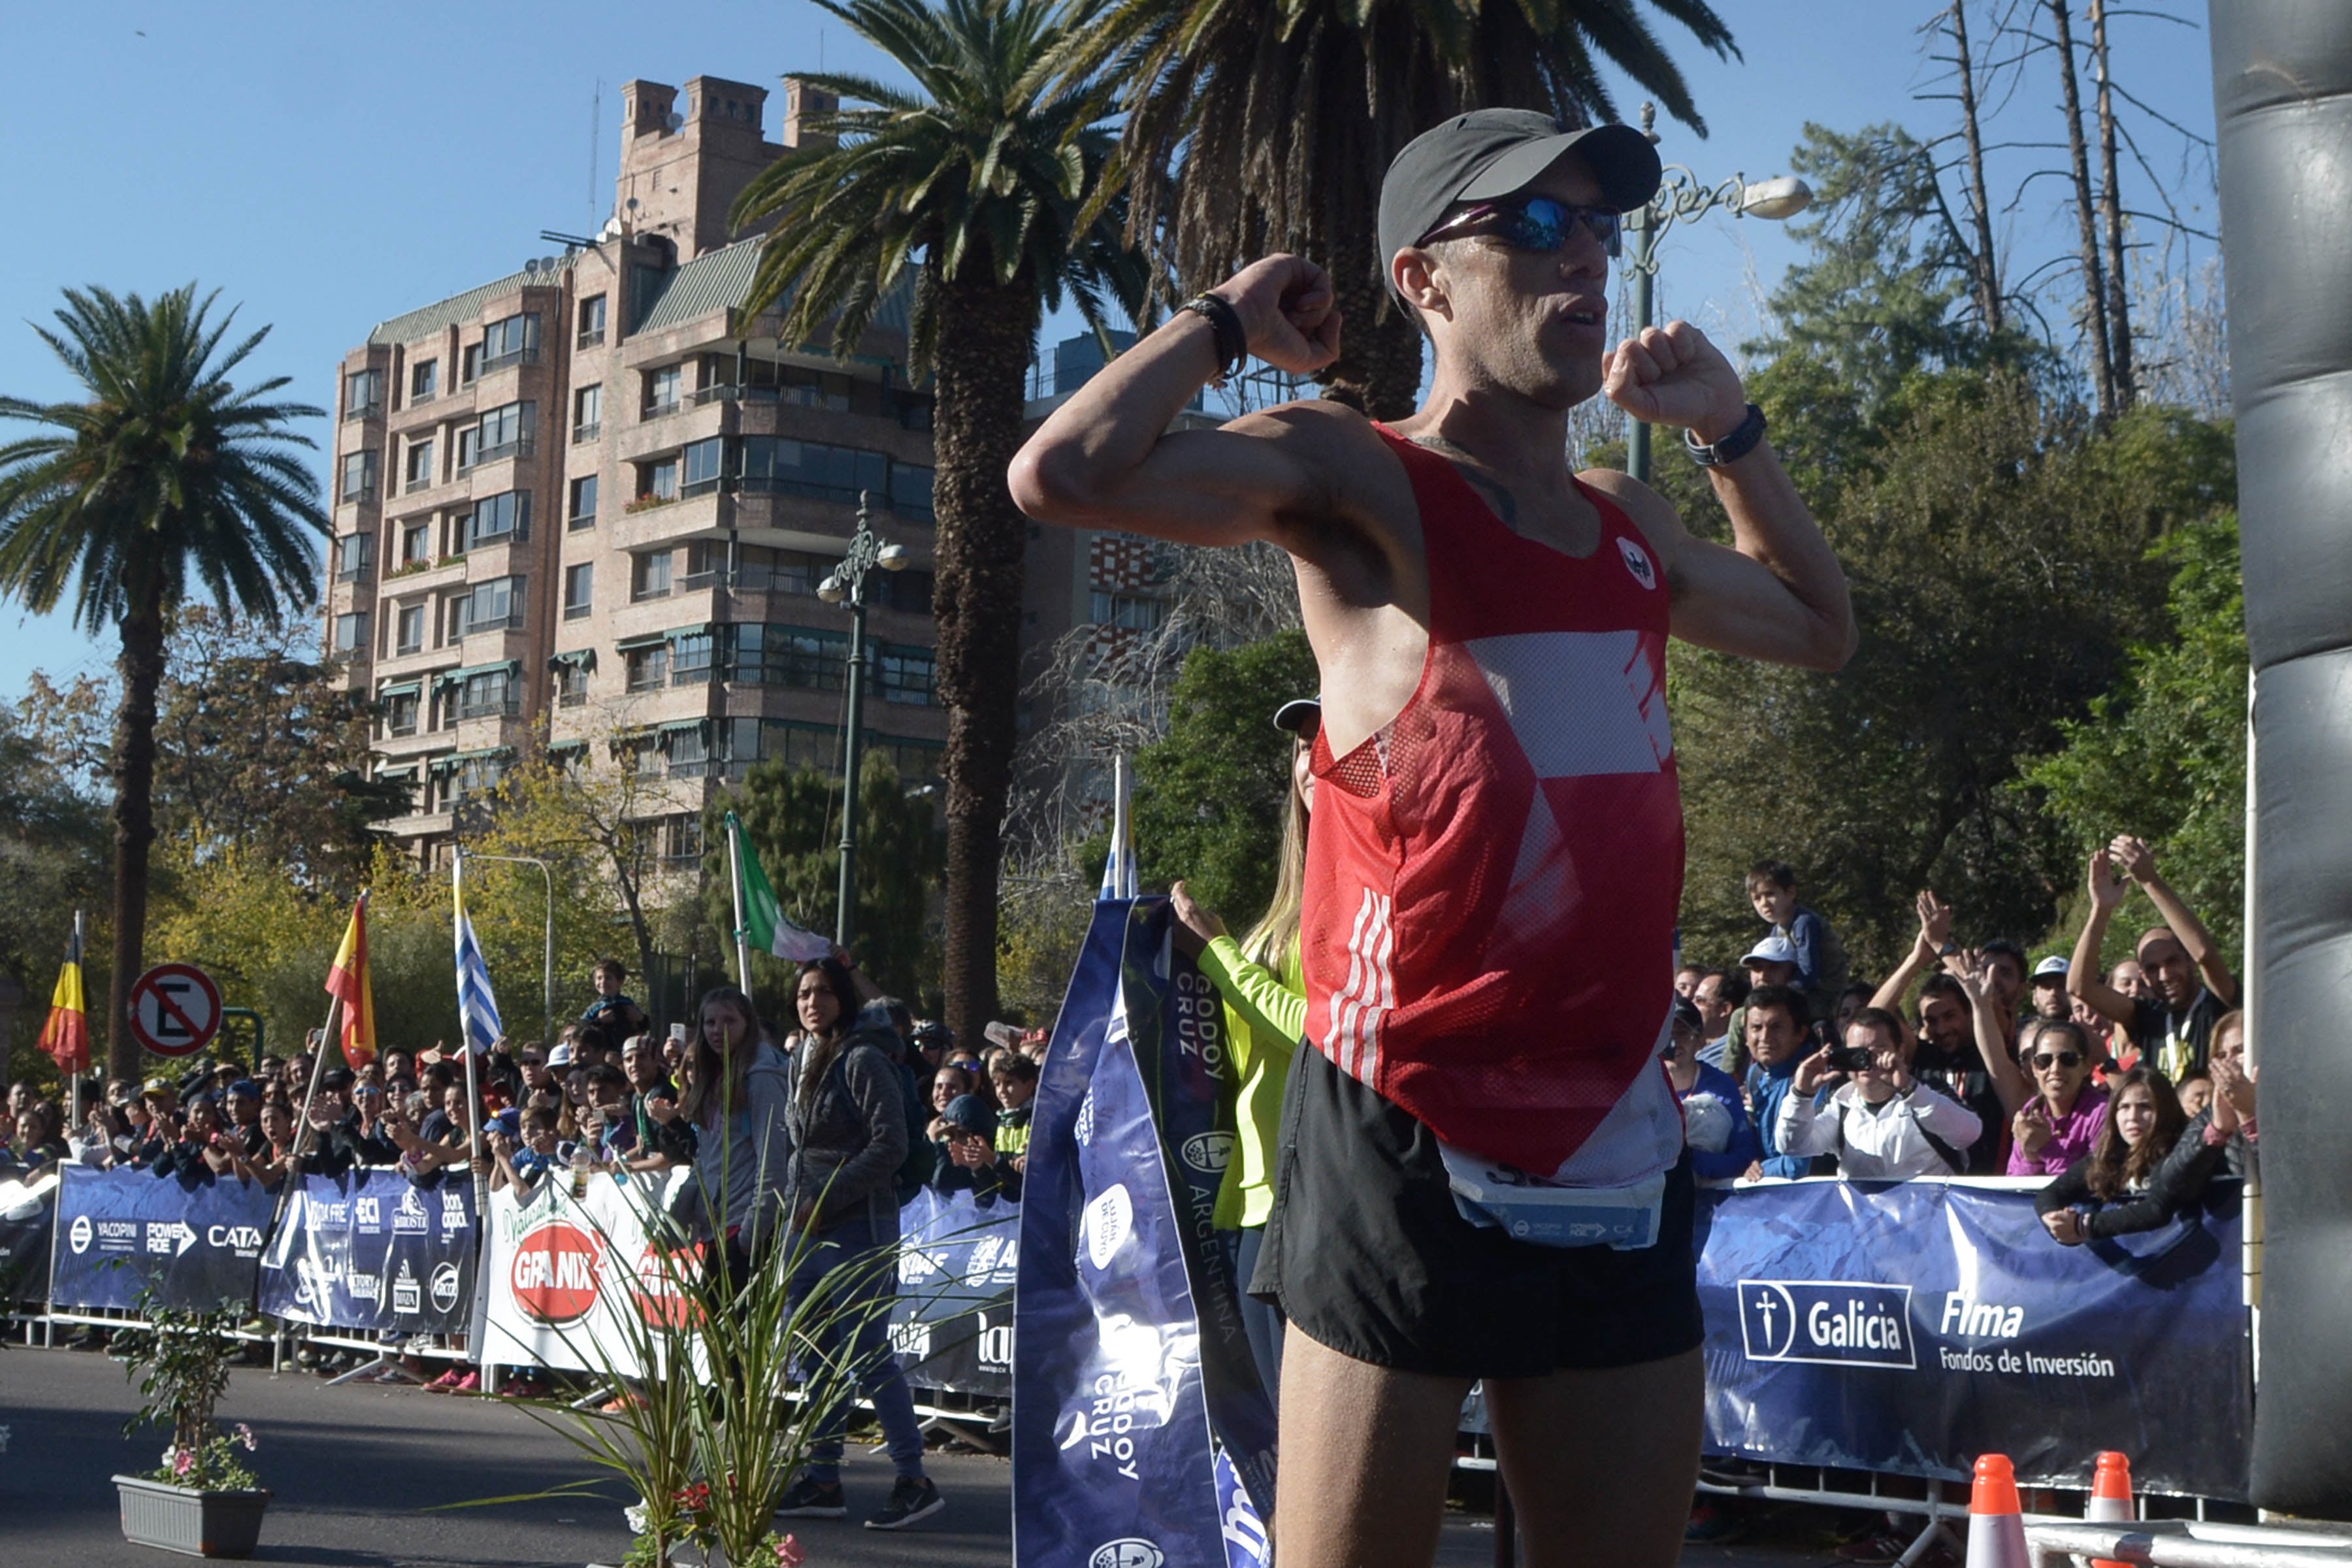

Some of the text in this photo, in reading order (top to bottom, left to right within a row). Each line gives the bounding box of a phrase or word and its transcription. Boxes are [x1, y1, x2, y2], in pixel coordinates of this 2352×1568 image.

[1177, 972, 1198, 1056] CRUZ
[1196, 973, 1224, 1080] GODOY
[97, 1222, 137, 1238] YACOPINI
[207, 1225, 263, 1248] CATA
[1098, 1201, 1109, 1257] DE CUYO
[1108, 1198, 1120, 1242] LUJÁN
[514, 1250, 593, 1290] GRANIX
[1188, 1184, 1236, 1344] ARGENTINA
[1807, 1299, 1903, 1351] Galicia
[1940, 1291, 2024, 1338] Fima
[1939, 1347, 2115, 1377] Fondos de Inversión
[1088, 1373, 1115, 1461] CRUZ
